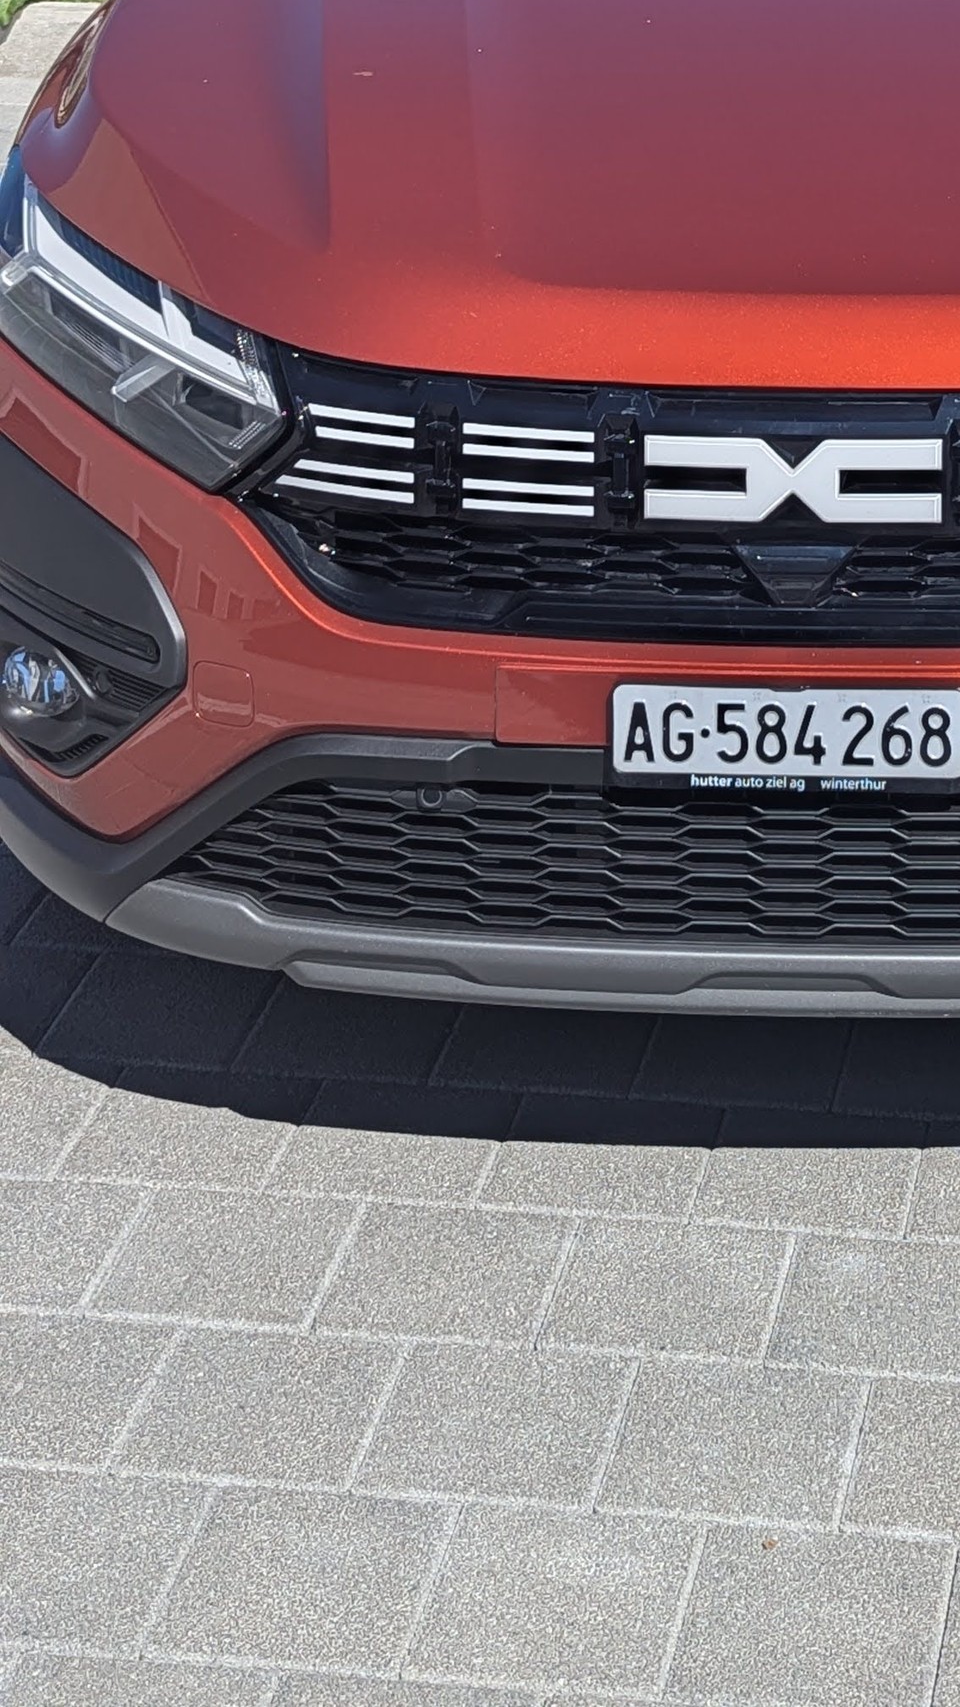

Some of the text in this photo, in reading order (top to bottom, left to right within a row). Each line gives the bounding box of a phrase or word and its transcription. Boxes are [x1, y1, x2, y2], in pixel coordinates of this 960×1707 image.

[690, 774, 887, 791] hutter auto ziel ag winterthur
